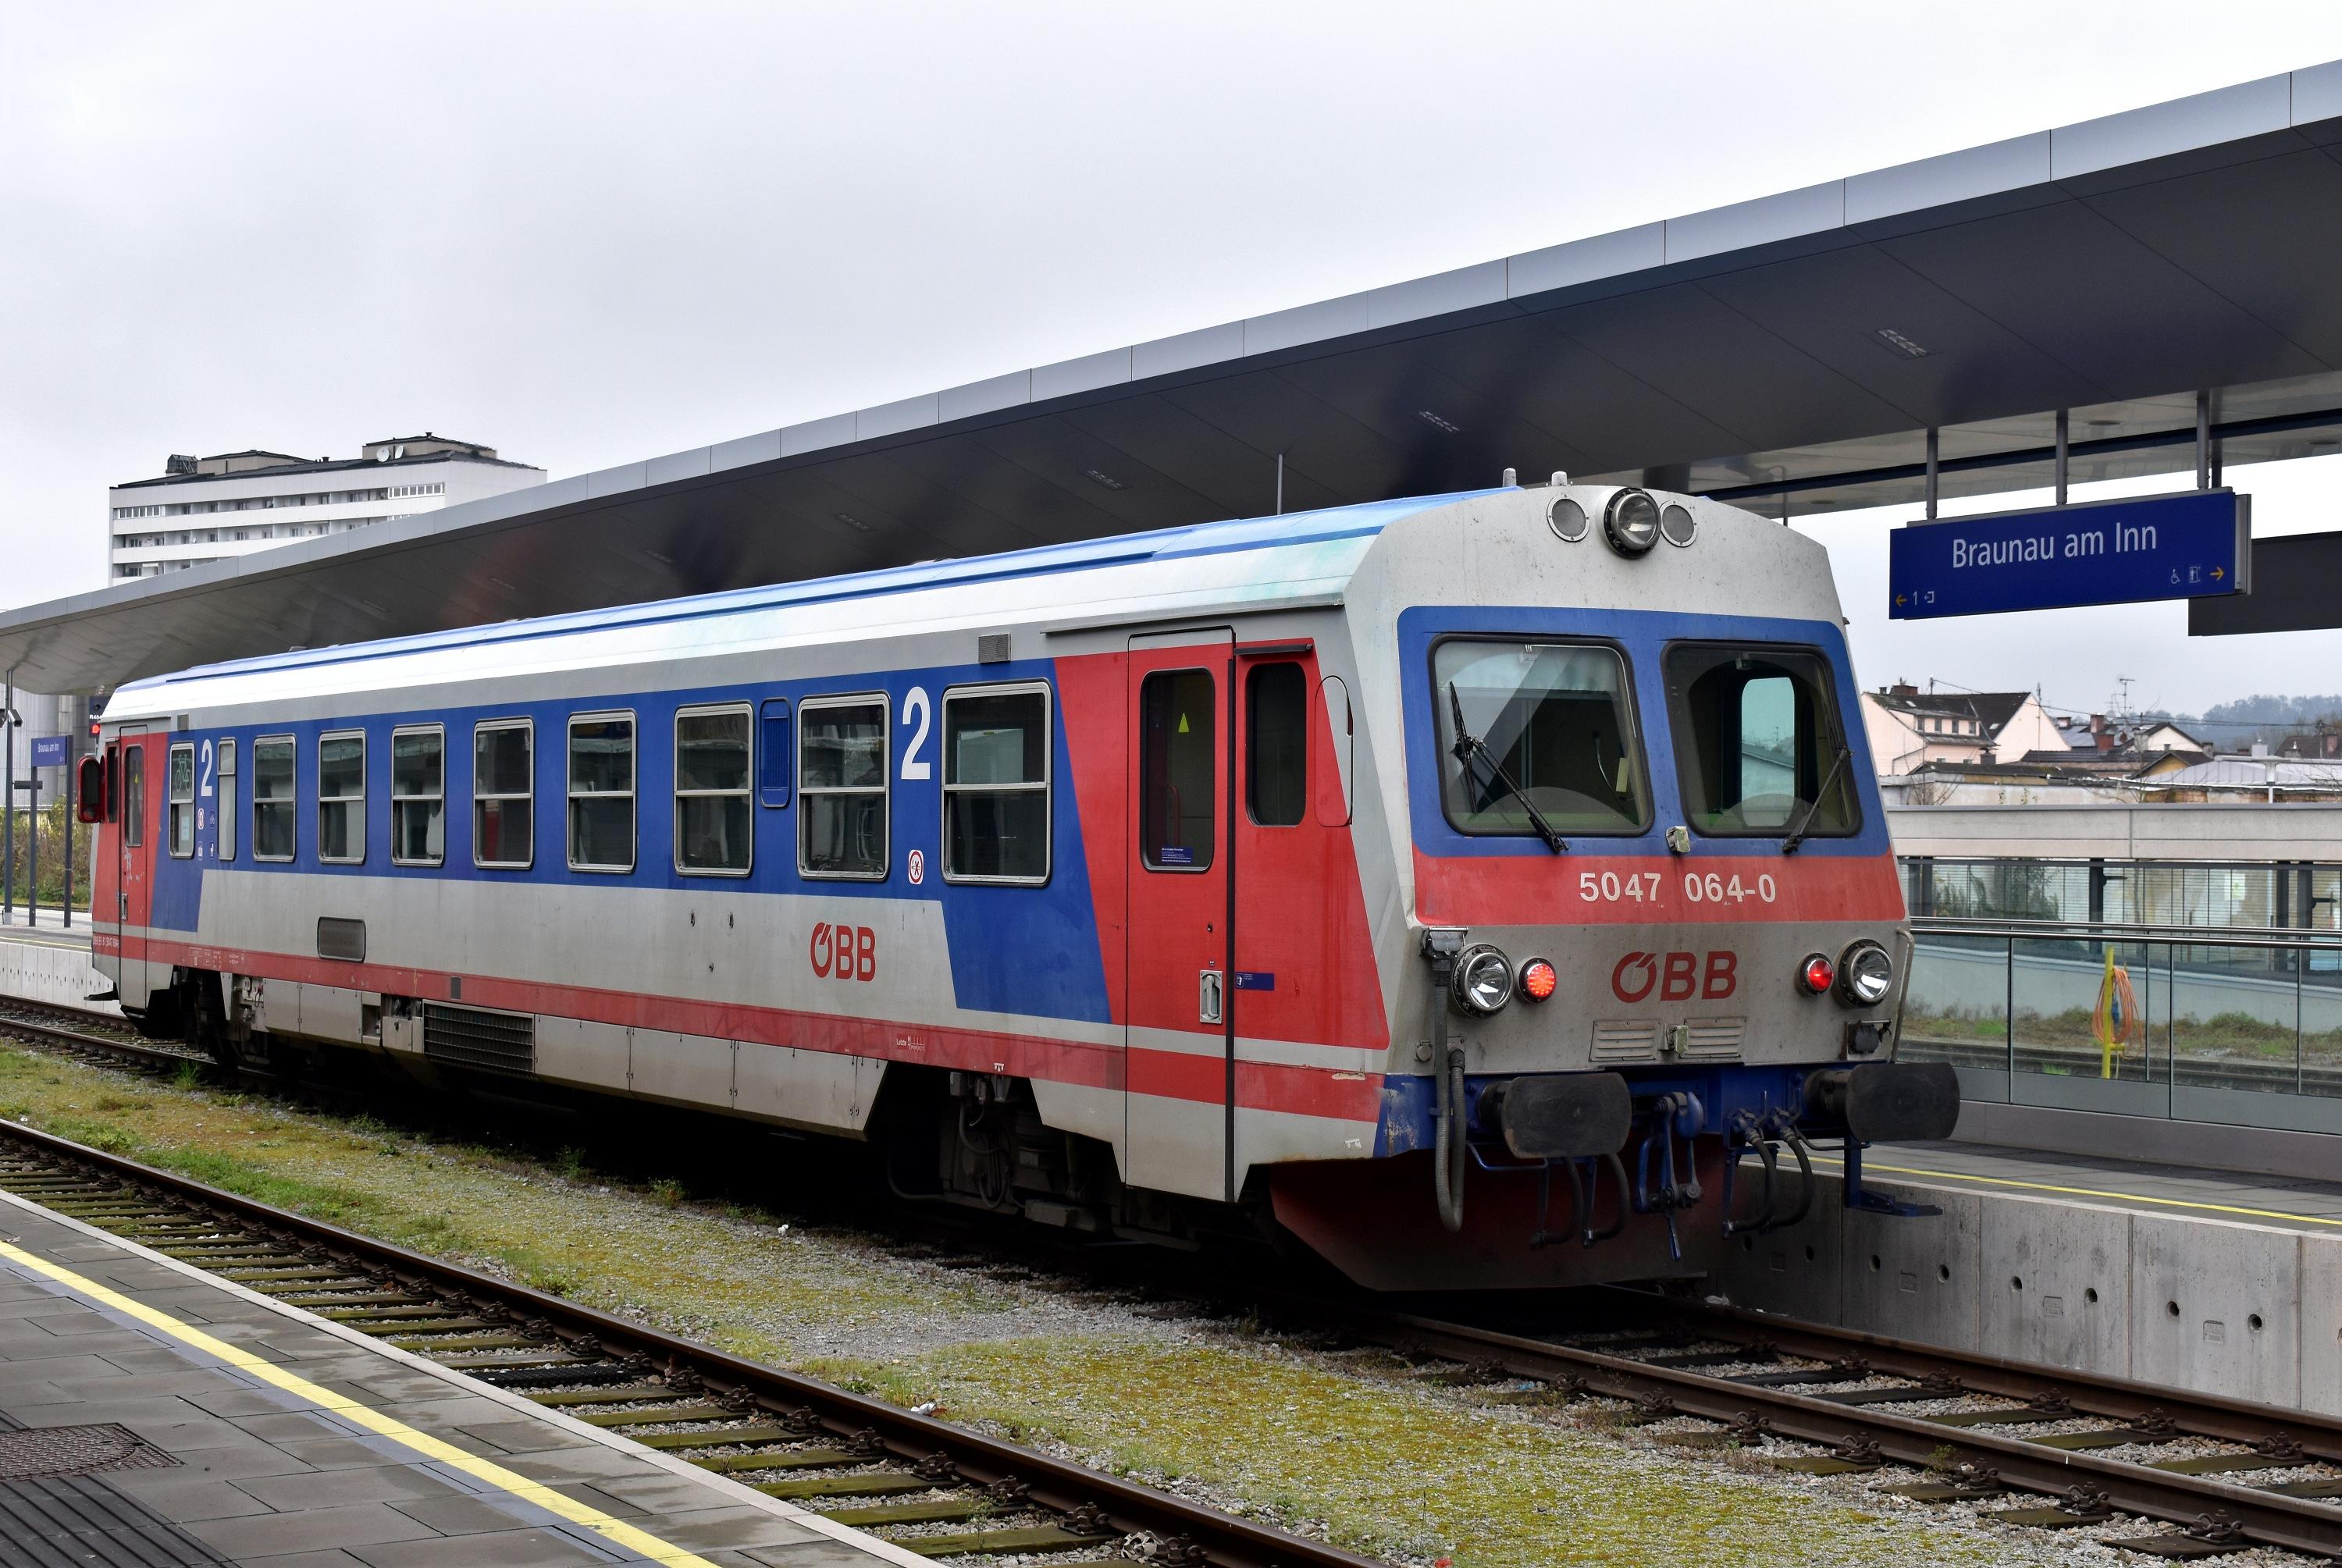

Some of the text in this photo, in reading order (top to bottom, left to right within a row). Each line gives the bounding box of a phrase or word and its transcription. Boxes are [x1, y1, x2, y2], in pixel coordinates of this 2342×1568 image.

[1952, 522, 2157, 568] Braunau am Inn
[1913, 591, 1917, 606] 1
[901, 686, 931, 780] 2
[201, 738, 213, 797] 2
[1579, 872, 1776, 903] 5047 064-0
